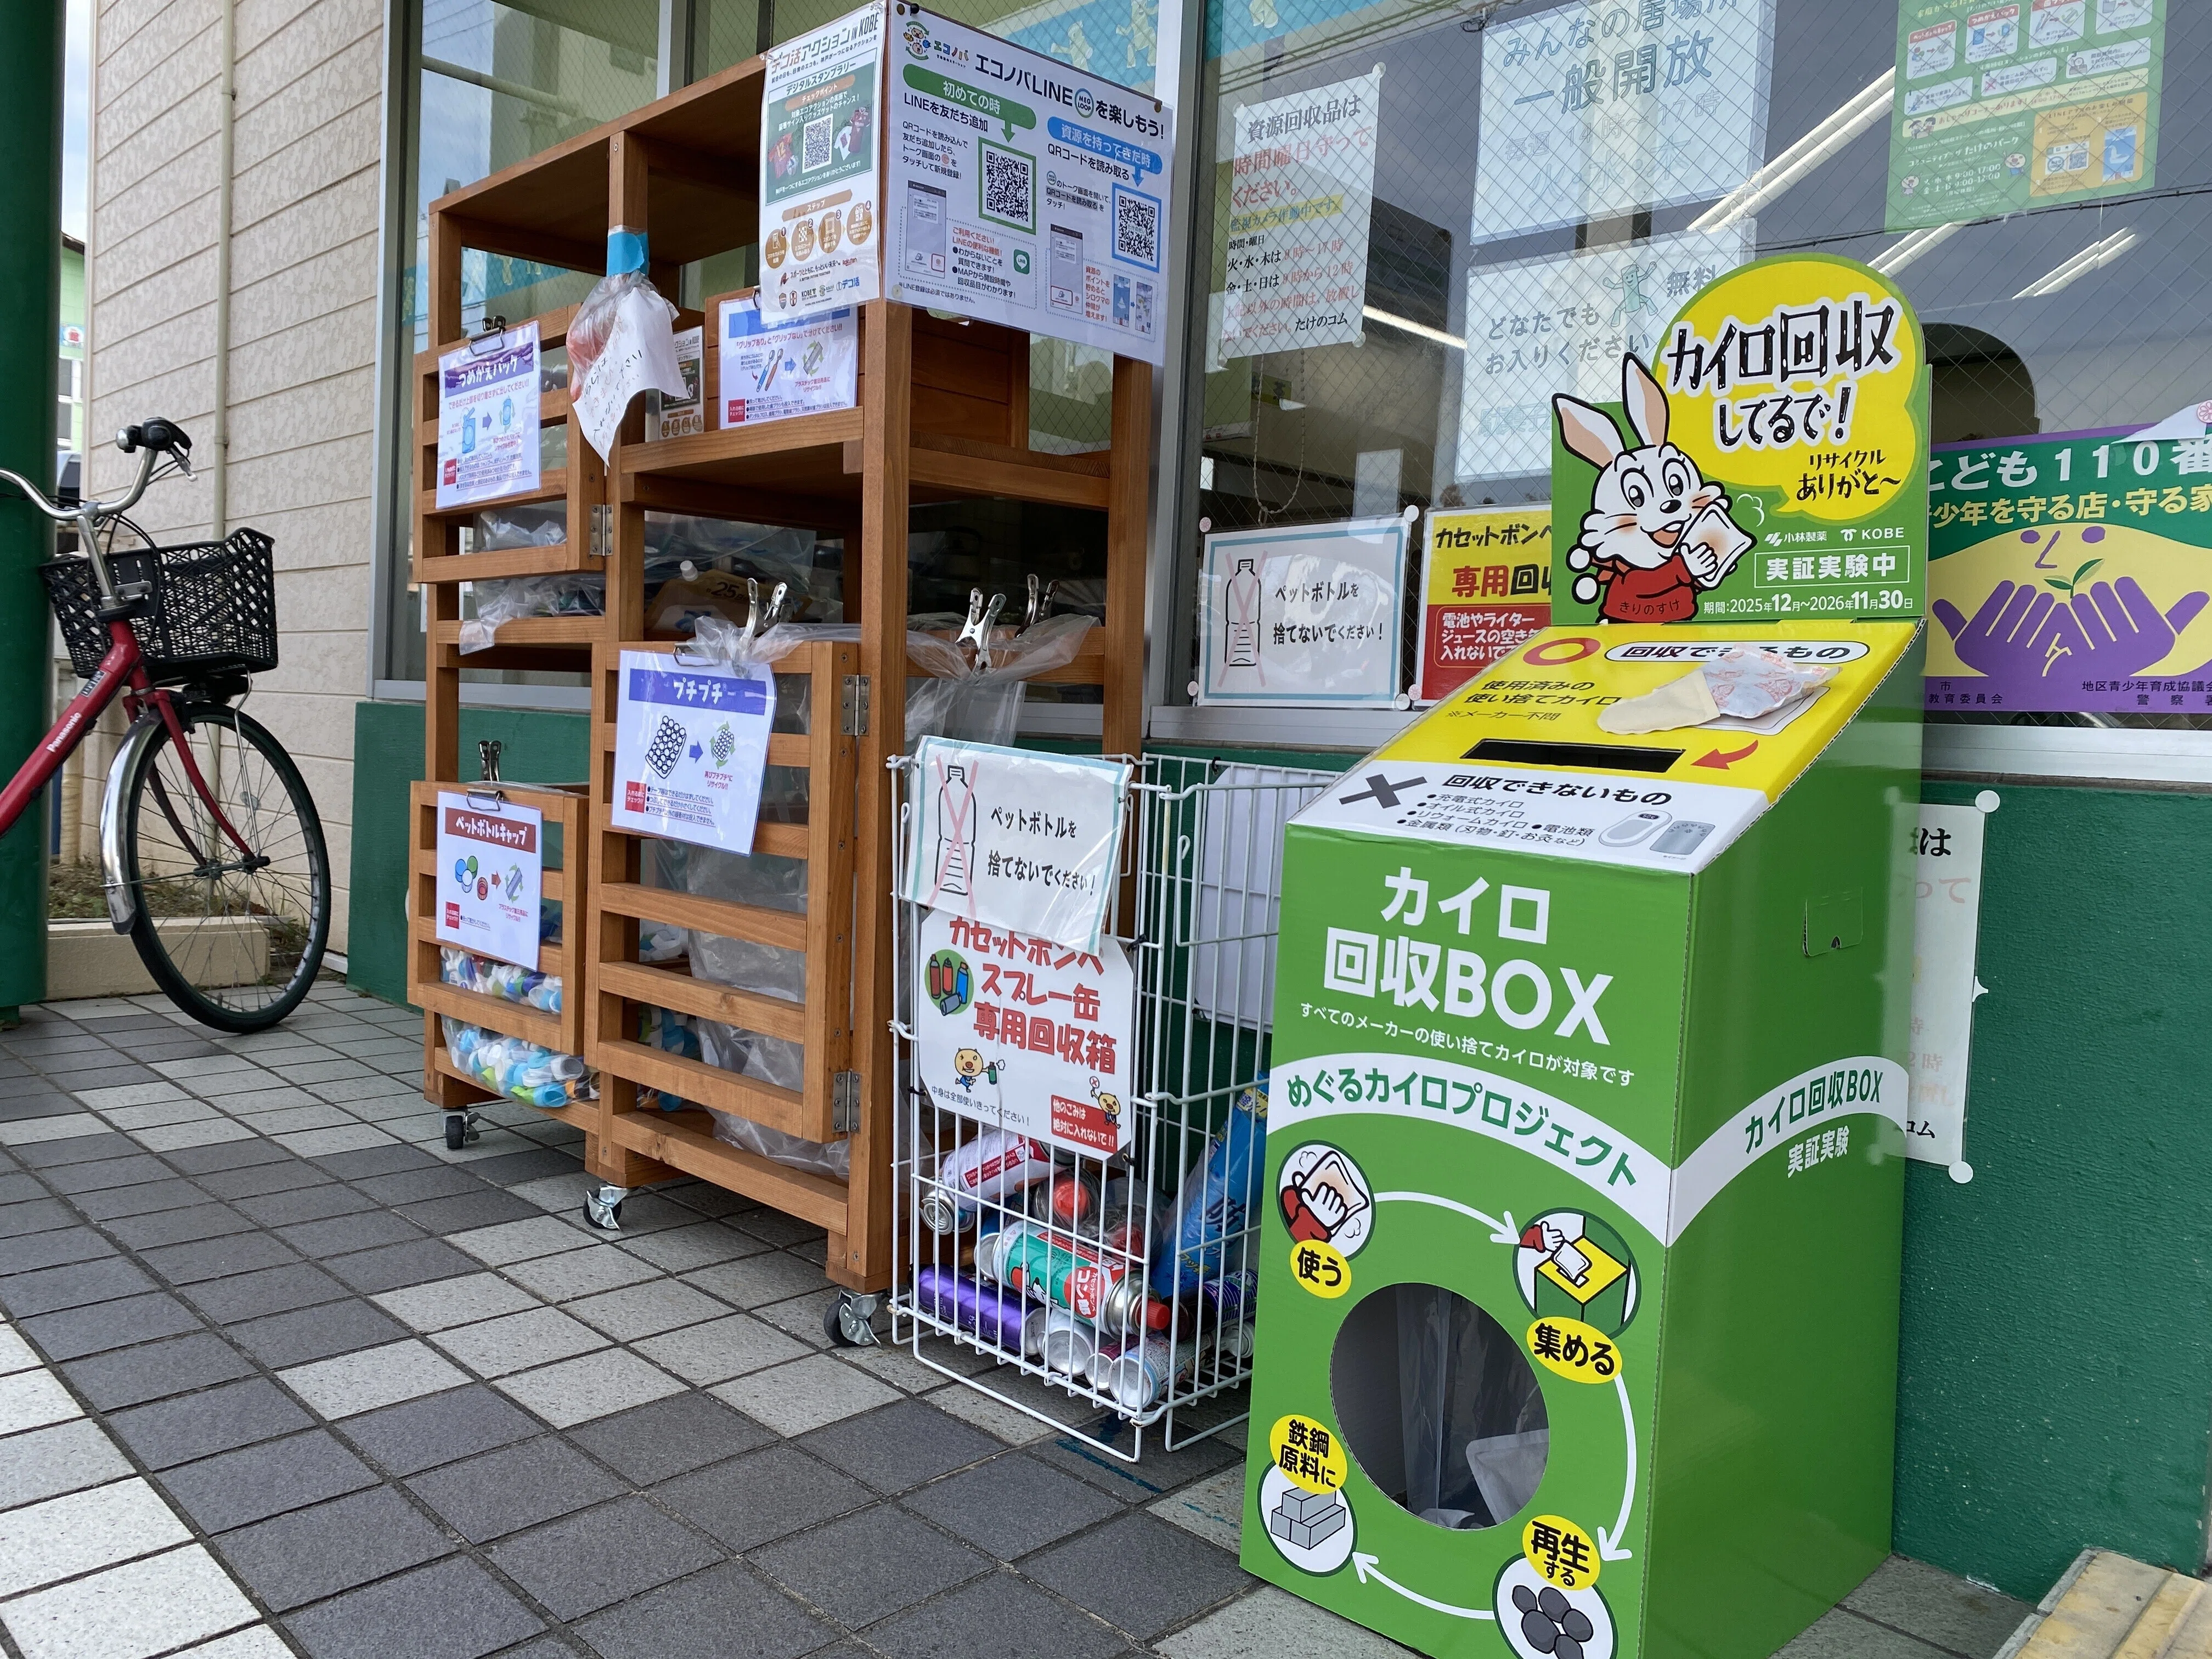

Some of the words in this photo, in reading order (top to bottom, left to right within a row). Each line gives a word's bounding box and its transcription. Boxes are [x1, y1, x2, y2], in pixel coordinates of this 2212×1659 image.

[859, 12, 879, 37] KOBE
[1972, 8, 2015, 24] つめかえパック
[934, 40, 969, 61] エコノバ
[786, 62, 856, 95] デジタルスタンプラリー
[1515, 30, 1714, 114] 一般開放
[802, 83, 837, 103] チェックポイント
[943, 81, 1001, 115] 初めての時
[975, 54, 1073, 107] エコノバLINE
[1077, 102, 1092, 112] LOOP
[1095, 99, 1165, 139] を楽しもう！
[904, 93, 989, 133] LINEを友だち追加
[1248, 94, 1361, 144] 資源回収品は
[902, 132, 955, 156] 友だち追加したら、
[903, 121, 968, 148] QRコードを読み込んで
[1504, 130, 1550, 161] 毎週
[1965, 137, 2019, 155] たけのパーク
[903, 144, 940, 161] トーク画面の
[1048, 144, 1129, 180] QRコードを読み取る
[1233, 127, 1373, 178] 時間曜日守って
[902, 156, 961, 179] タッチして新規登録！
[1047, 188, 1097, 208] QRコードを読み取る
[1047, 199, 1065, 210] タッチ！
[1232, 179, 1297, 208] ください。
[807, 200, 825, 212] ステップ
[1230, 199, 1340, 232] 監視カメラ作動中です。
[952, 236, 1002, 256] LINEの便利な機能！
[953, 227, 994, 244] ご利用ください！
[1228, 234, 1265, 251] 時間・曜日
[958, 258, 994, 273] 質問できます！
[1086, 266, 1101, 275] 資源の
[1228, 251, 1281, 273] 火・水・木は
[802, 289, 812, 297] KOBE
[842, 276, 860, 289] デコ活
[899, 282, 975, 303] ※LINE登録は必須ではありません。
[957, 278, 1015, 298] 回収品目がわかります！
[1086, 276, 1110, 287] ポイントを
[1086, 284, 1105, 295] 貯めると
[1226, 275, 1280, 296] 金・土・日は
[1086, 294, 1110, 305] シロクマの
[1086, 302, 1101, 311] 仲間が
[1086, 310, 1107, 322] 増えます！
[1295, 312, 1348, 331] たけのコム
[1489, 303, 1600, 340] どなたでも
[1486, 334, 1649, 374] お入りください
[1667, 300, 1895, 390] カイロ回収
[459, 354, 518, 387] つめかえパック
[1720, 386, 1852, 447] してるで！
[1810, 450, 1886, 472] リサイクル
[1928, 484, 2212, 528] 少年を守る店・守る家
[1784, 531, 1828, 543] 小林製薬
[1861, 528, 1905, 540] KOBE
[1766, 552, 1896, 580] 実証実験中
[1275, 582, 1359, 603] ペットボトルを
[1620, 600, 1680, 616] きりのすけ
[1442, 612, 1535, 629] 電池やライター
[1273, 622, 1383, 645] 捨てないでください！
[1620, 644, 1852, 659] 回収でもの
[1482, 680, 1595, 692] 使用済みの
[1940, 681, 1951, 691] 市
[1464, 693, 1622, 707] 使い捨てカイロ
[1929, 693, 2002, 705] 教育委員会
[1447, 709, 1561, 723] ※メーカー不問
[46, 712, 82, 753] Panasonic
[627, 789, 645, 798] 入れる前に
[1442, 774, 1672, 805] 回収できないもの
[1426, 802, 1525, 819] オイル式カイロ
[1438, 794, 1524, 809] 充電式カイロ
[455, 816, 528, 845] ペットボトルキャップ
[991, 806, 1076, 838] ペットボトルを
[1418, 810, 1529, 830] リウォームカイロ
[1543, 824, 1595, 838] 電池類
[988, 850, 1096, 896] 捨てないでください！
[1381, 867, 1550, 945] カイロ
[981, 963, 1101, 1022] スプレー缶
[1324, 927, 1613, 1046] 回収BOX
[974, 1001, 1116, 1075] 専用回収箱
[1301, 1002, 1635, 1087] すべてのメーカーの使い捨てカイロが対象です
[932, 1086, 1030, 1126] 中身は全部使いきってください！
[1052, 1099, 1086, 1120] 他のごみは
[1745, 1068, 1883, 1155] カイロ回収BOX
[1287, 1068, 1638, 1188] めぐるカイロプロジェクト
[1787, 1125, 1850, 1178] 実証実験
[1297, 1249, 1342, 1287] 使う
[1534, 1322, 1616, 1376] 集める
[1289, 1419, 1330, 1458] 鉄鋼
[1279, 1443, 1337, 1489] 原料に
[1531, 1520, 1590, 1574] 再生
[1545, 1560, 1577, 1587] する
